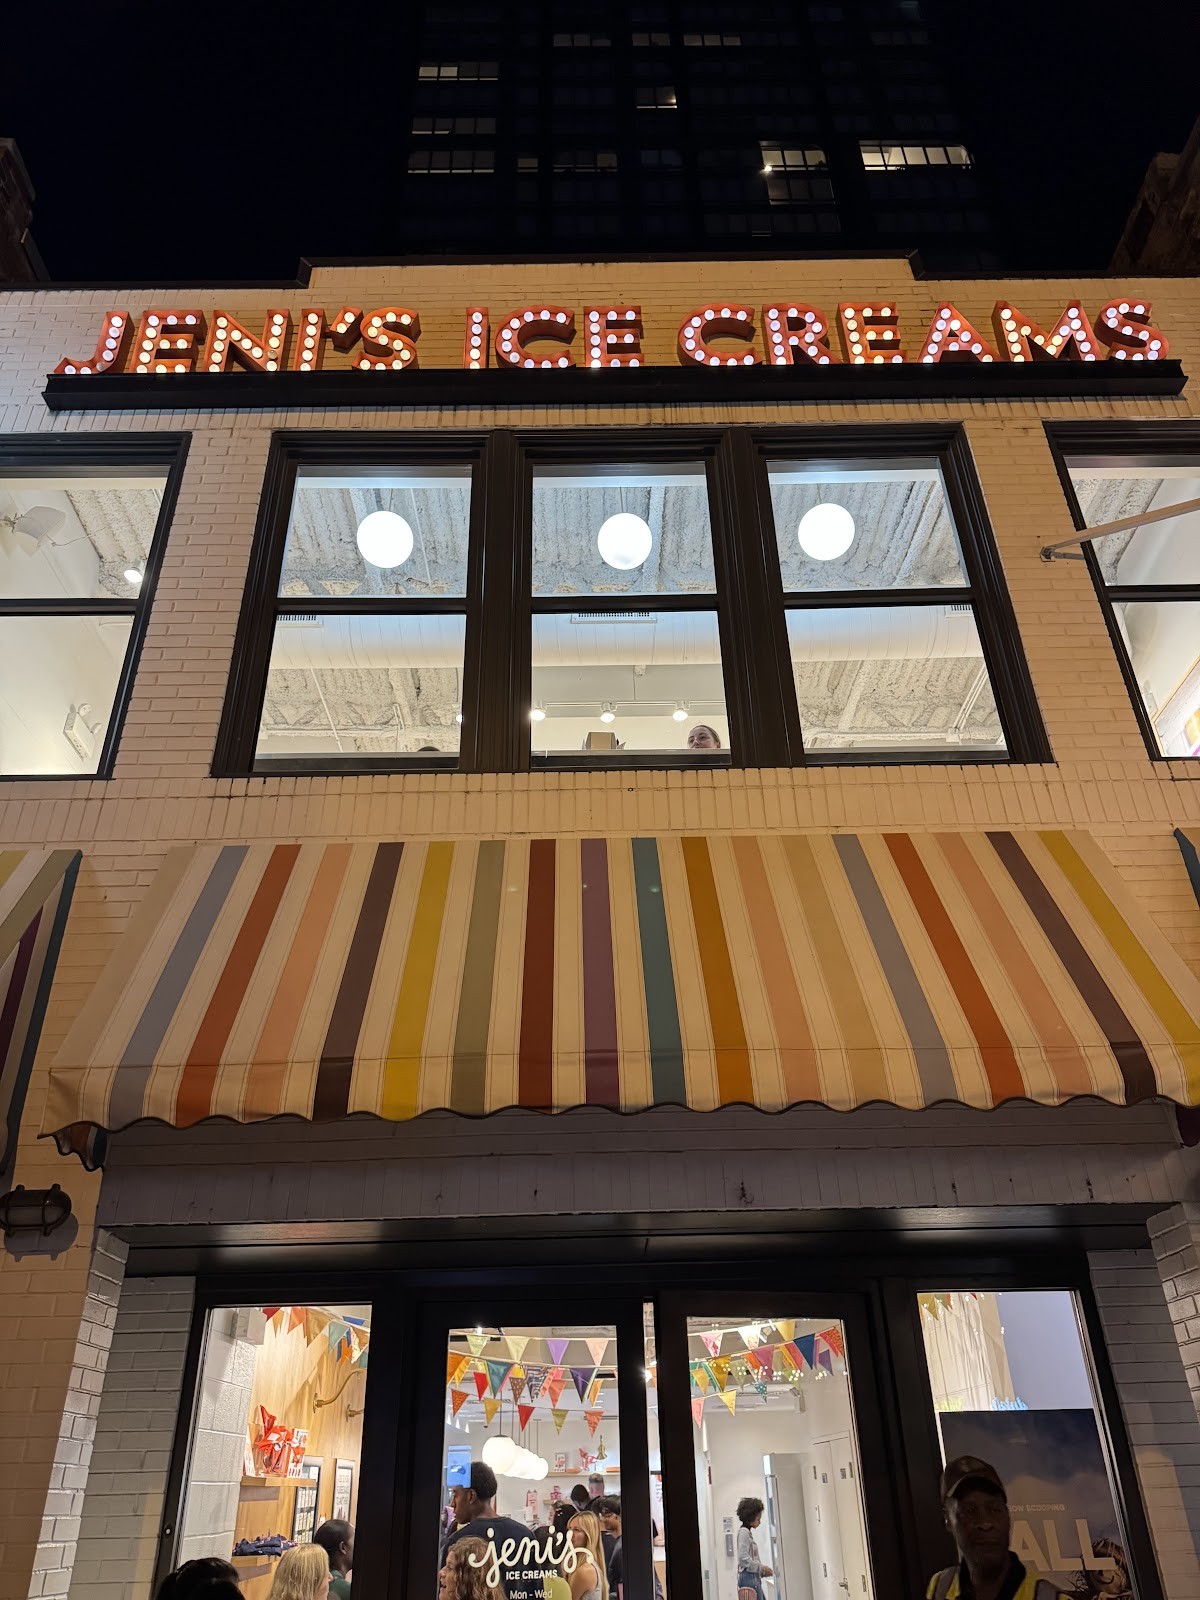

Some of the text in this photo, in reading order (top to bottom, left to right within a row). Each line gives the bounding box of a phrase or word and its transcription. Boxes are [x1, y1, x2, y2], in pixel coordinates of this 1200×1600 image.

[54, 298, 1170, 374] JENI'S ICE CREAMS
[1026, 1504, 1065, 1512] SCOOPING
[468, 1525, 595, 1588] jeni's
[505, 1569, 557, 1580] ICE CREAMS
[509, 1590, 527, 1599] Mon
[535, 1588, 553, 1599] Wed
